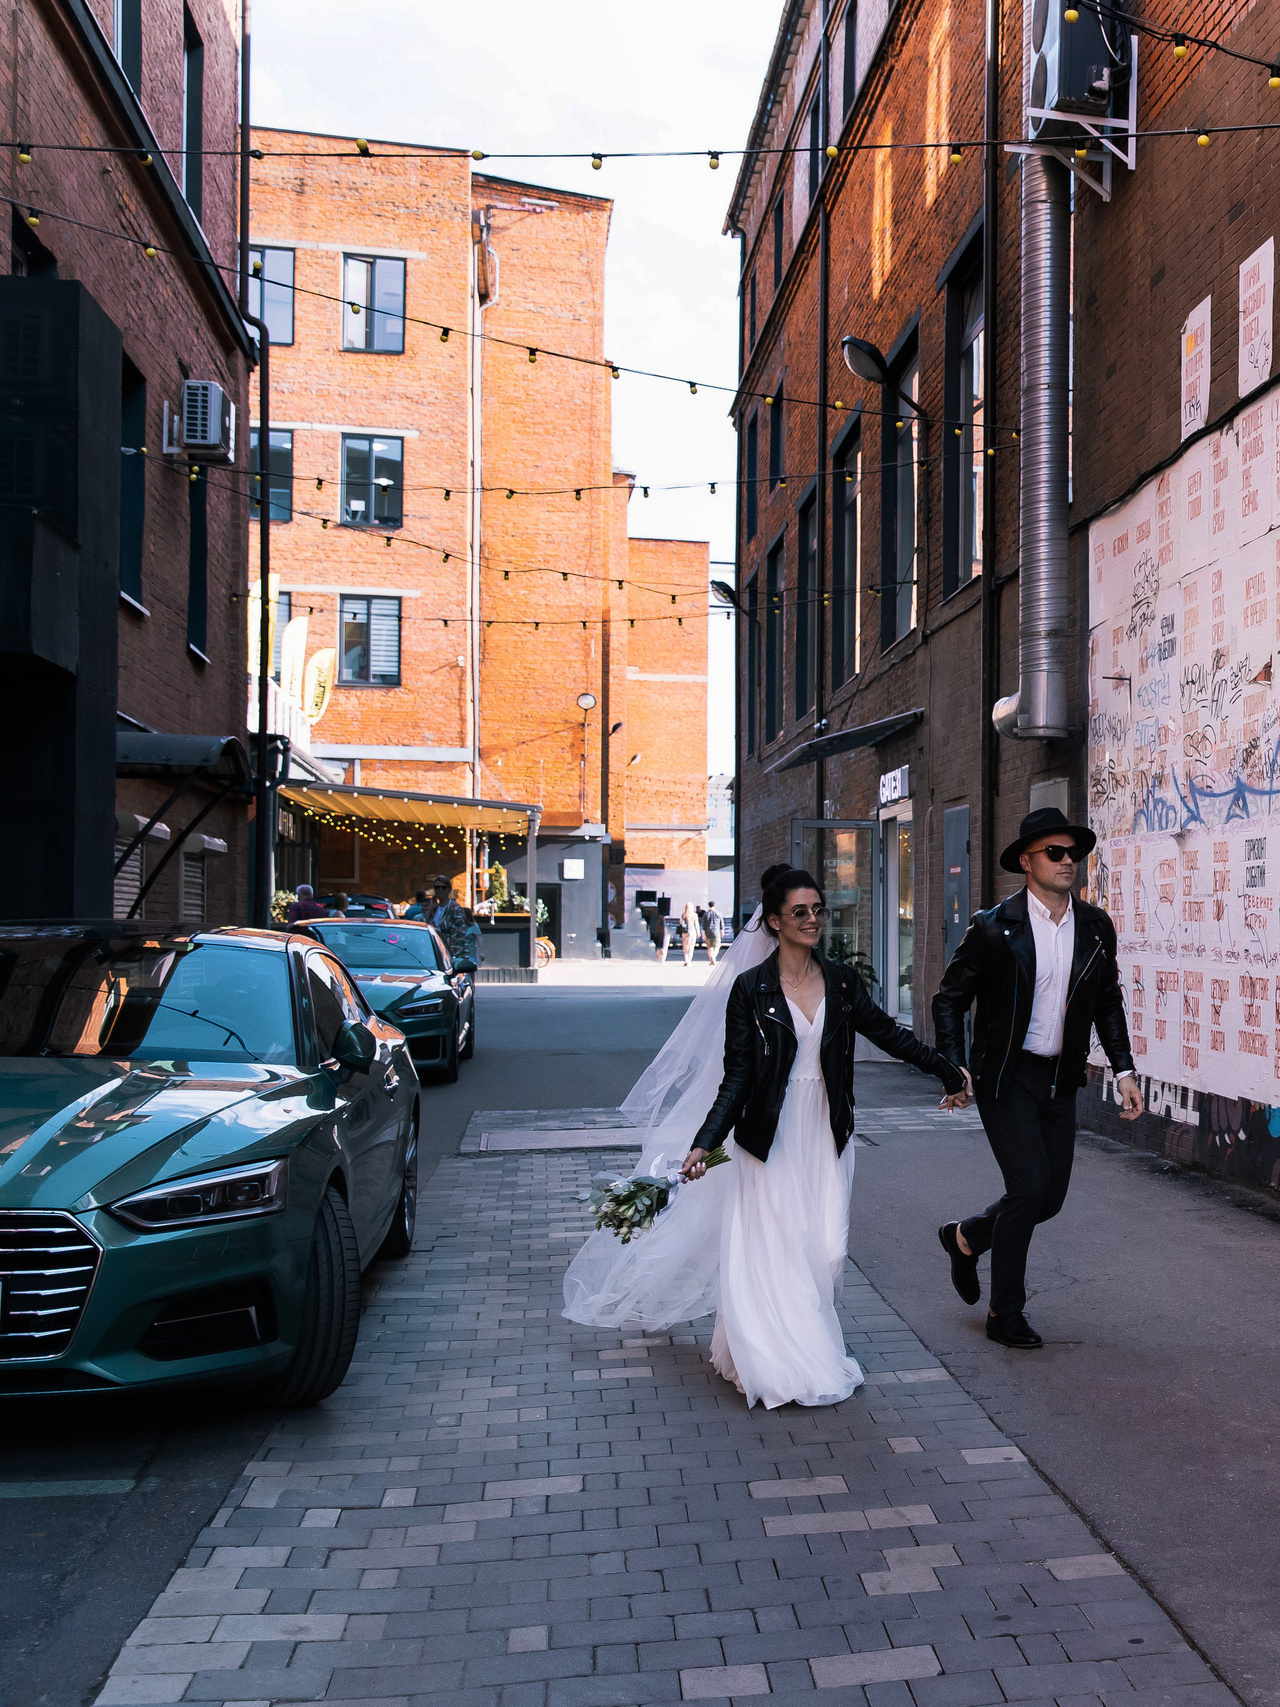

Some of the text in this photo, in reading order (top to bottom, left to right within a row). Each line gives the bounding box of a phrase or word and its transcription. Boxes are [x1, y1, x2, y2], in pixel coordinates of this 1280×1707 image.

[1242, 404, 1262, 439] БУДУЩЕЕ
[1242, 465, 1251, 491] УЖЕ
[1241, 487, 1258, 519] СЕЙЧАС
[1245, 570, 1265, 601] МЕЧТАТЬ
[1244, 597, 1266, 629] НЕ ВРЕДНО
[1244, 837, 1266, 861] ГОРИЗОНТ
[1245, 861, 1265, 888] СОБЫТИЙ
[1274, 1056, 1280, 1079] НЕ
